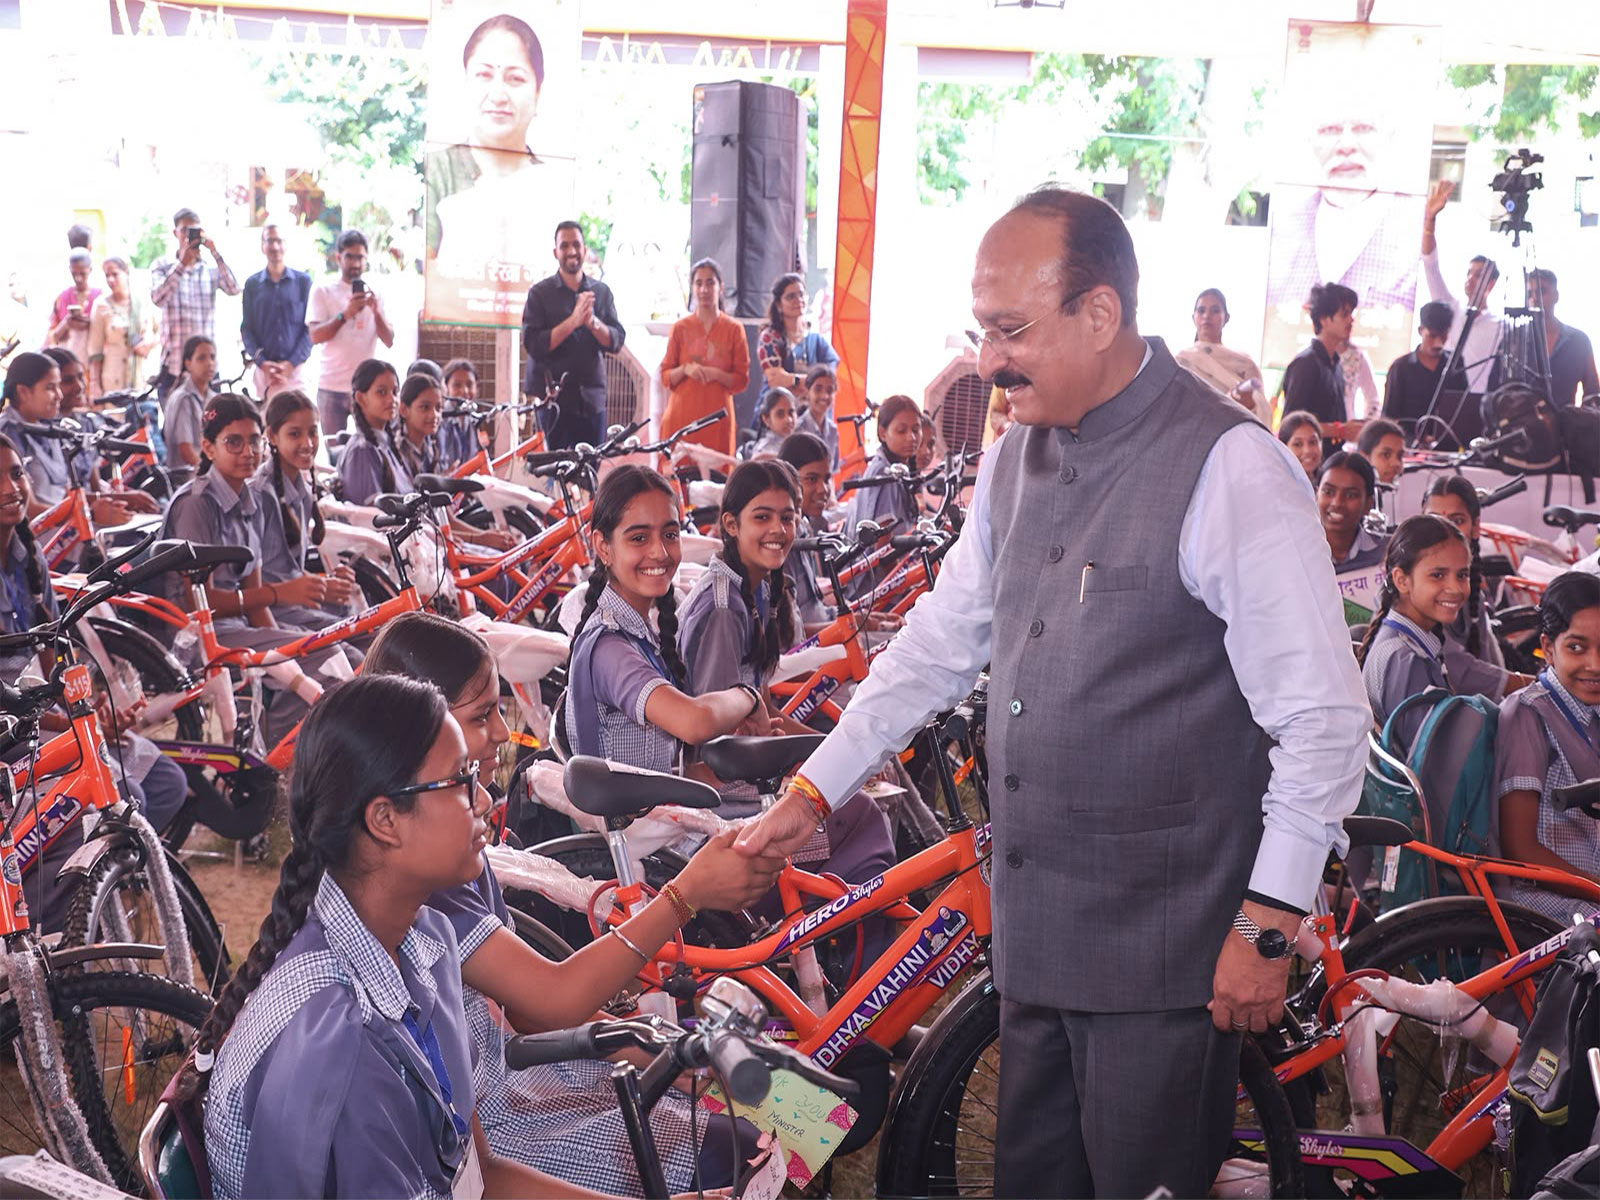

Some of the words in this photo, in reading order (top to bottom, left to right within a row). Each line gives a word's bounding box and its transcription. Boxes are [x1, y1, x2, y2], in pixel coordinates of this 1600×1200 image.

[514, 578, 547, 614] VAHINI
[14, 824, 47, 863] HINI
[789, 894, 850, 943] HERO
[852, 877, 884, 900] Skyler
[929, 931, 980, 989] VIDHY
[1529, 922, 1582, 962] HER
[811, 1013, 873, 1072] IDHYA
[864, 943, 931, 1012] VAHINI
[32, 1011, 53, 1070] HERO
[1300, 1136, 1345, 1161] Skyler
